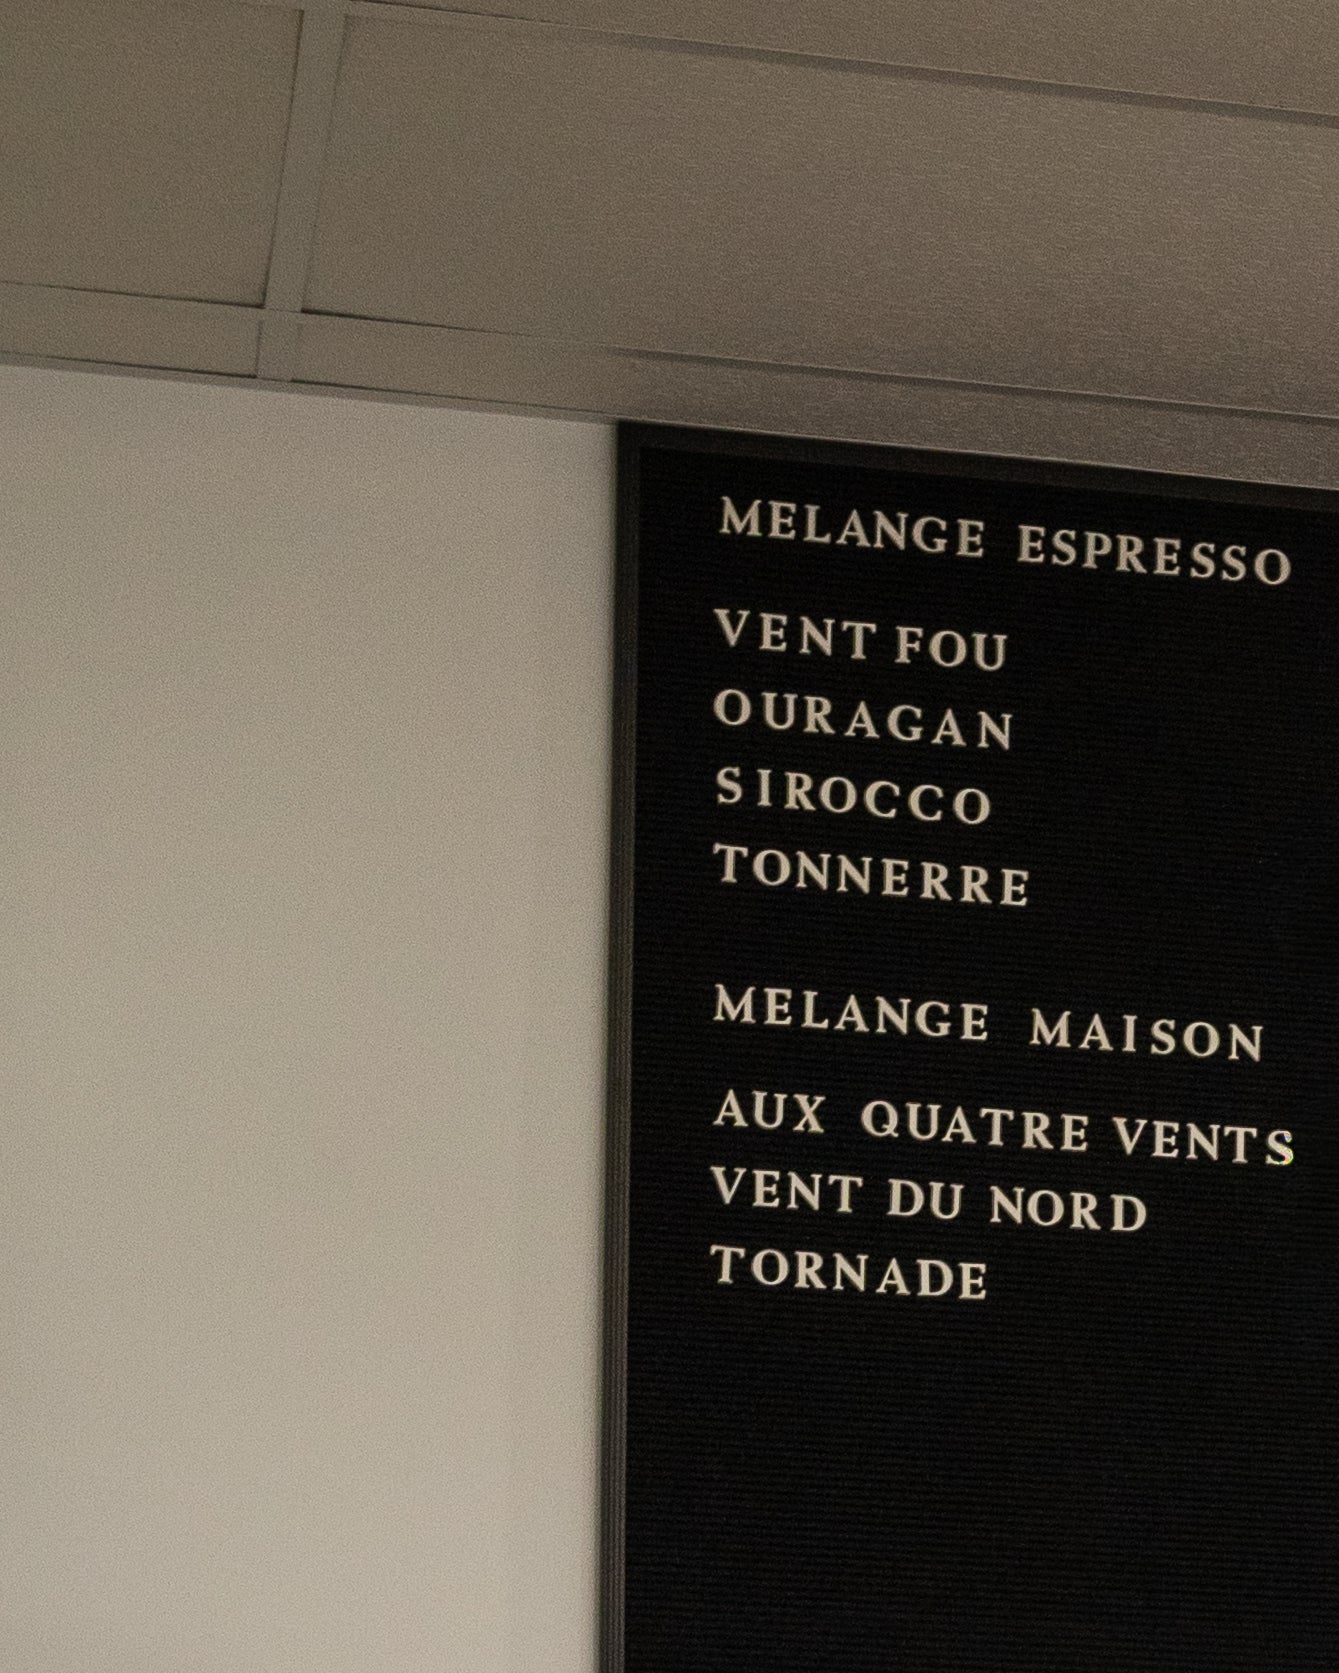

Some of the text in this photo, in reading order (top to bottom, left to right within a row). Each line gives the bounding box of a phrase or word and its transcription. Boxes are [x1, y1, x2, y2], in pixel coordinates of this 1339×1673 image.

[719, 495, 1291, 585] MELANGE ESPRESSO
[712, 607, 1008, 671] VENT FOU
[713, 687, 1012, 750] OURAGAN
[715, 765, 990, 825] SIROCCO
[712, 841, 1029, 907] TONNERRE
[712, 982, 1264, 1062] MELANGE MAISON
[712, 1087, 1294, 1166] AUX QUATRE VENTS
[708, 1165, 1147, 1232] VENT DU NORD
[709, 1243, 987, 1300] TORNADE
